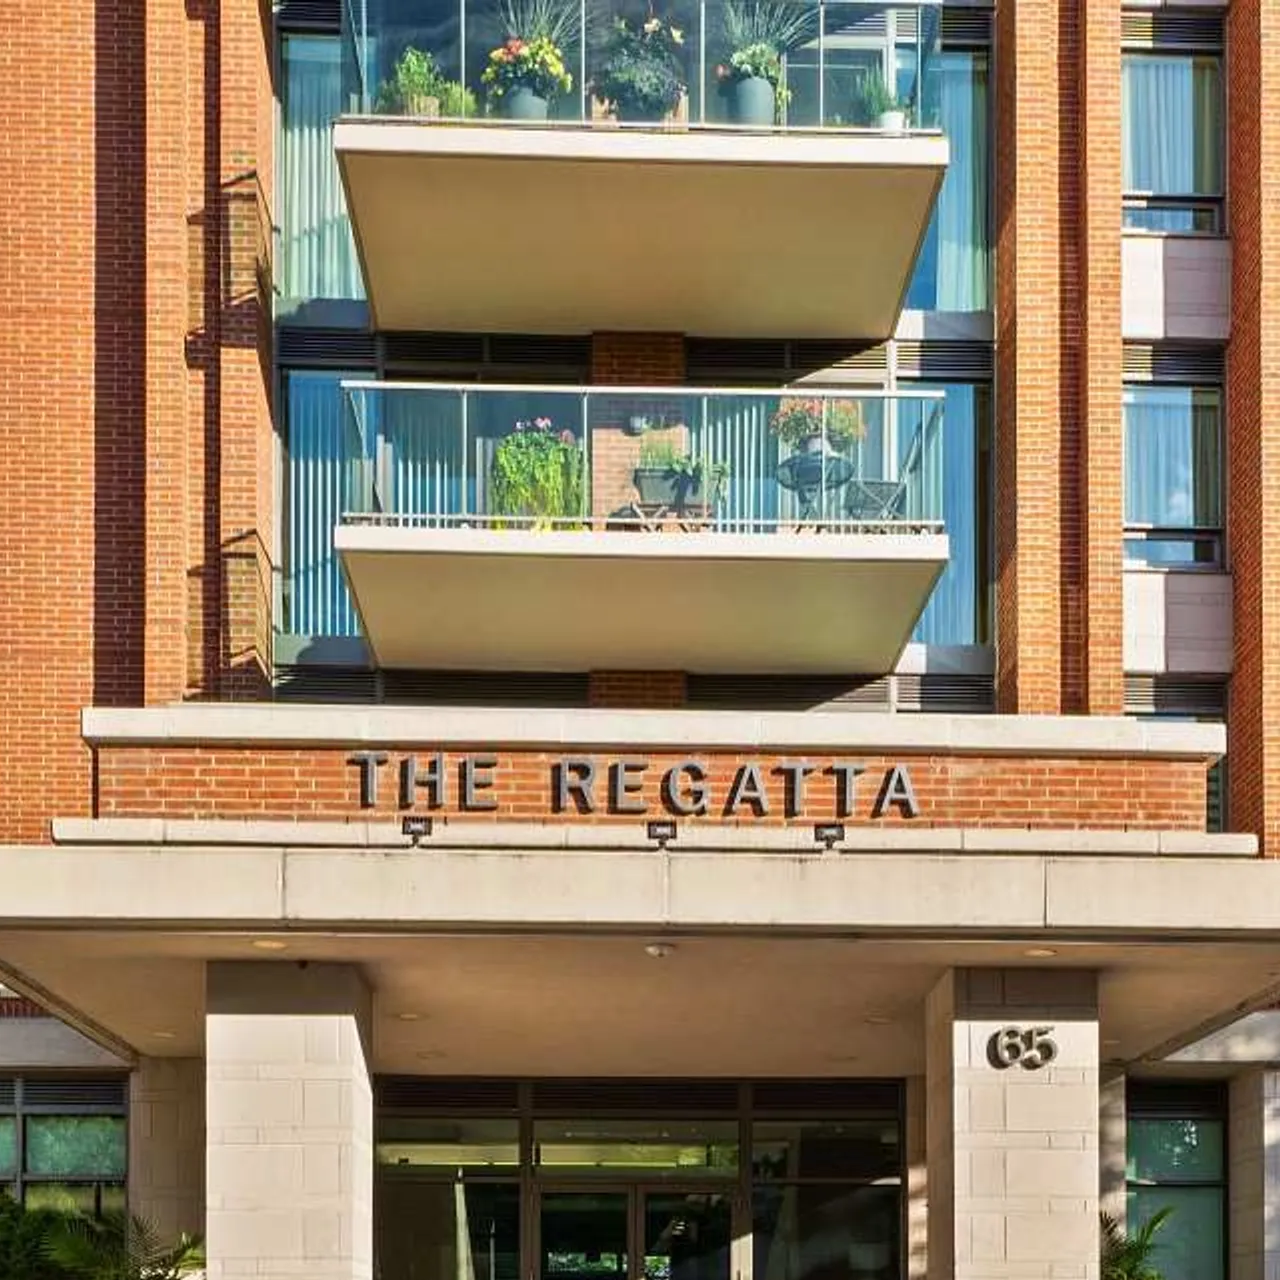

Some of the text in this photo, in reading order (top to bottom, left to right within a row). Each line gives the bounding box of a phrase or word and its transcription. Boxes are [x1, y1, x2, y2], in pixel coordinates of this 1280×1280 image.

[346, 750, 920, 819] THE REGATTA
[986, 1025, 1058, 1070] 65
